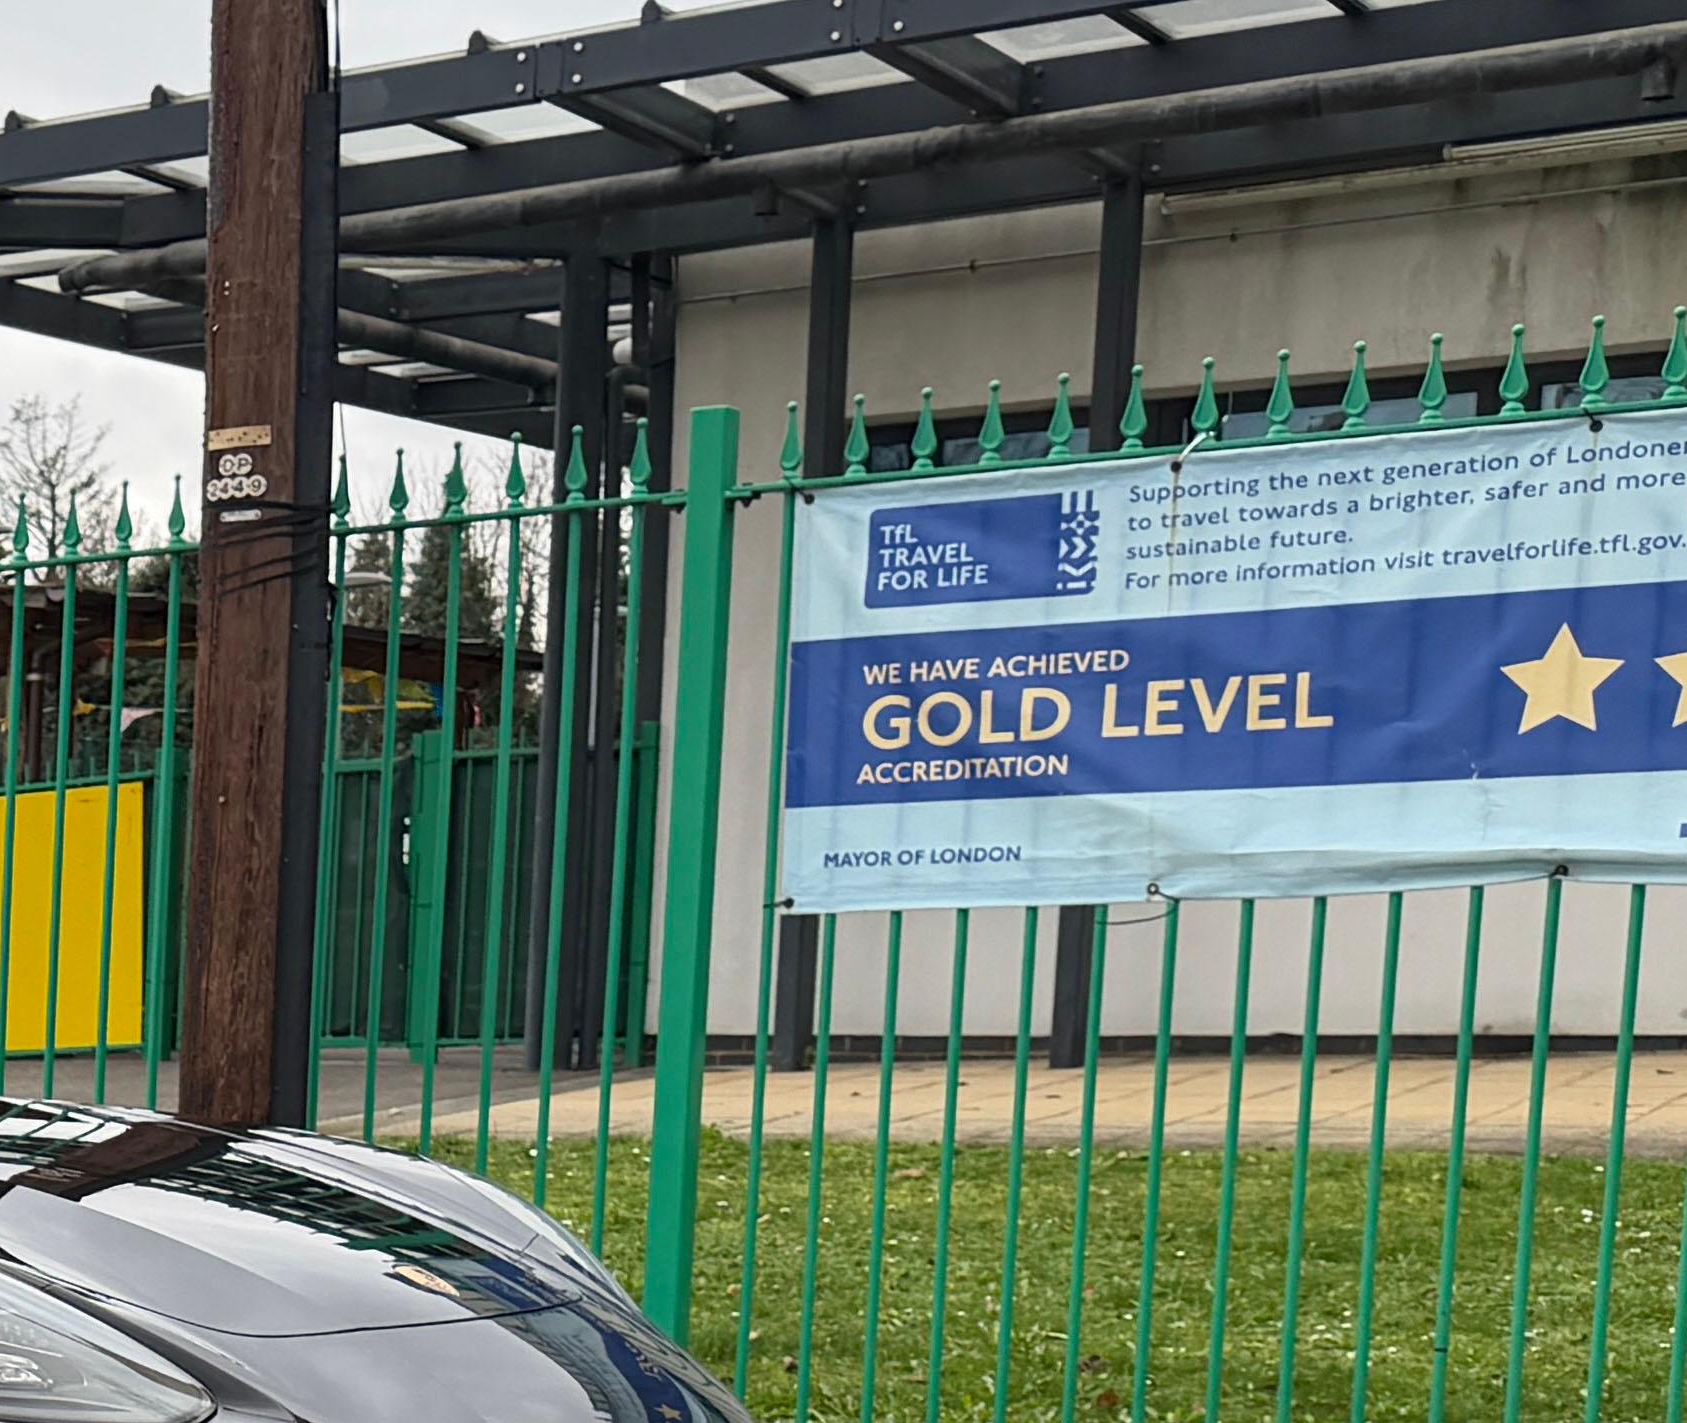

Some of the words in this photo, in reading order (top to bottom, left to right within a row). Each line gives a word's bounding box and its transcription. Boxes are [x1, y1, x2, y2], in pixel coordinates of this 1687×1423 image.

[1129, 478, 1259, 505] Supporting
[1269, 472, 1308, 491] the
[1317, 465, 1374, 487] next
[1382, 454, 1519, 485] generation
[1529, 447, 1557, 468] of
[1128, 515, 1152, 532] to
[1161, 507, 1230, 528] travel
[1239, 499, 1338, 522] towards
[1347, 499, 1359, 514] a
[1369, 487, 1474, 513] brighter,
[1484, 480, 1549, 502] safer
[1558, 473, 1605, 496] and
[1616, 471, 1686, 491] more
[879, 524, 919, 545] TfL
[1126, 533, 1261, 560] sustainable
[1270, 529, 1354, 549] future.
[879, 542, 974, 568] TRAVEL
[1125, 572, 1161, 590] For
[1168, 568, 1229, 587] more
[1236, 556, 1376, 582] information
[1384, 550, 1435, 571] visit
[1442, 533, 1687, 566] travelforlife.tfl.gov.
[877, 569, 929, 592] FOR
[936, 564, 989, 588] LIFE
[863, 663, 902, 686] WE
[909, 657, 980, 682] HAVE
[987, 649, 1130, 678] ACHIEVED
[862, 686, 1072, 751] GOLD
[1100, 671, 1334, 739] LEVEL
[856, 753, 1070, 785] ACCREDITATION
[824, 850, 892, 869] MAYOR
[896, 849, 925, 866] OF
[930, 846, 1022, 865] LONDON
